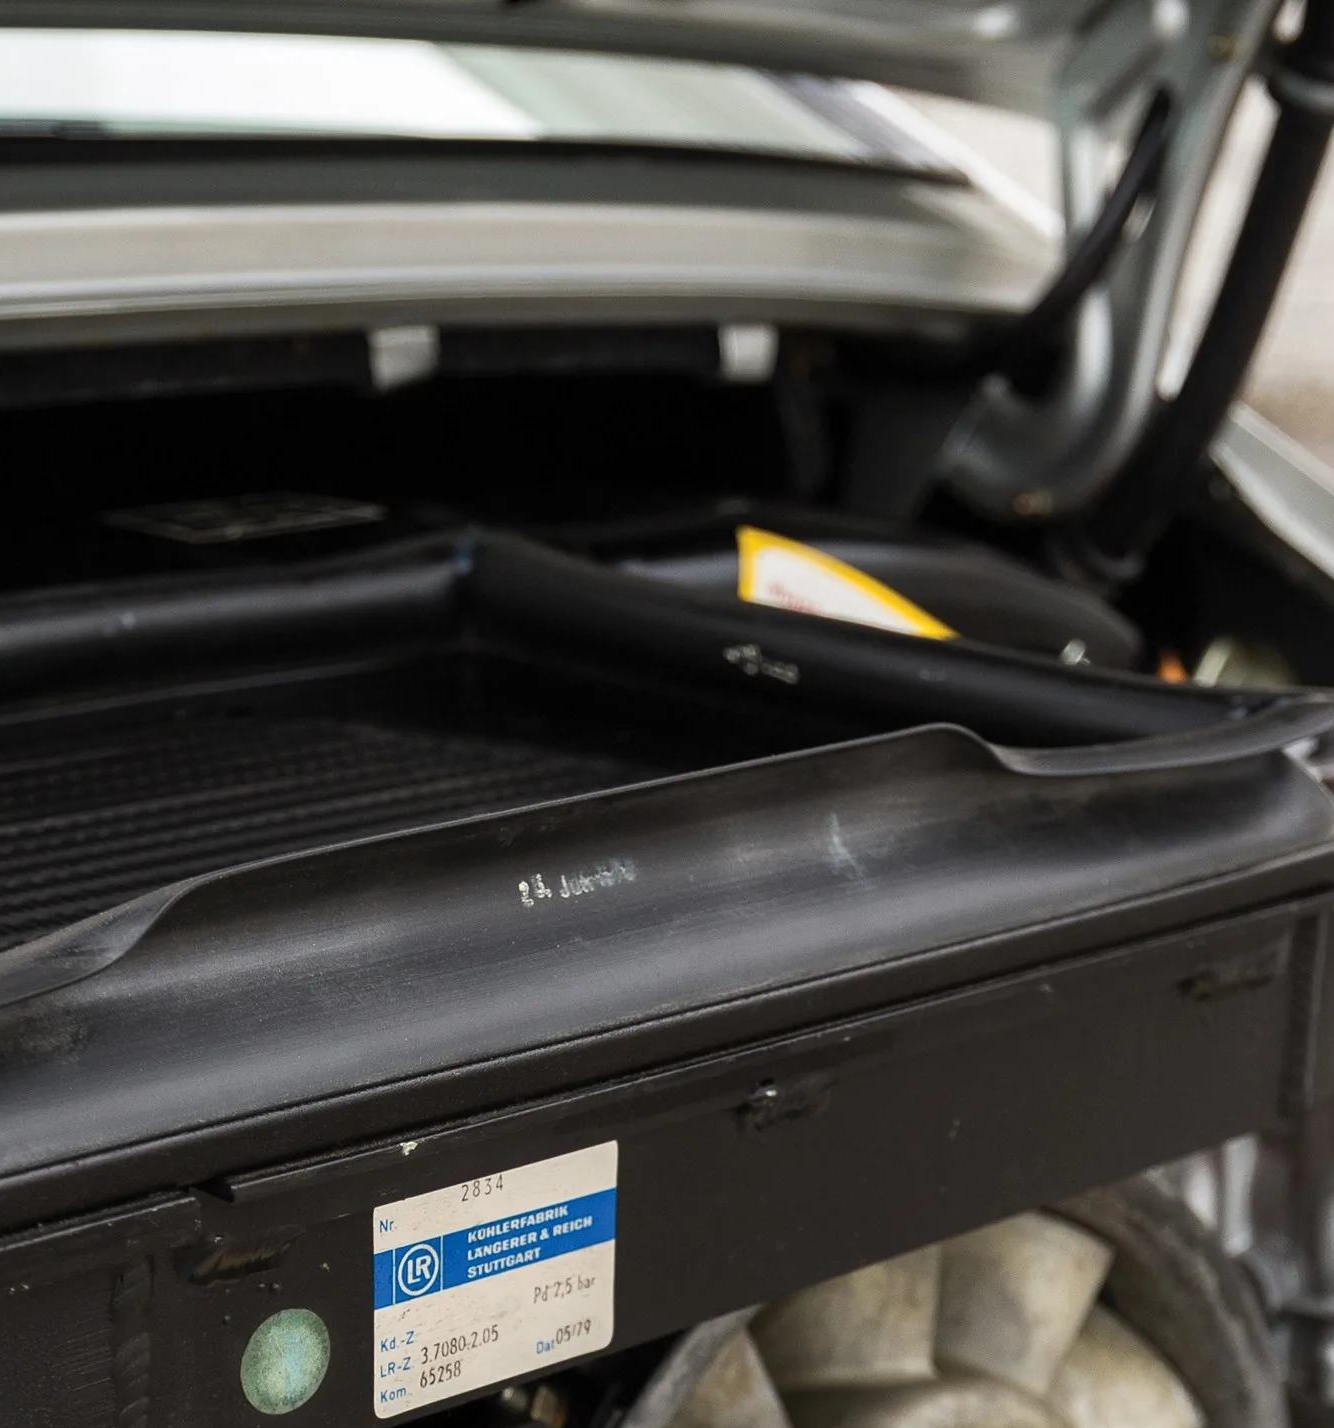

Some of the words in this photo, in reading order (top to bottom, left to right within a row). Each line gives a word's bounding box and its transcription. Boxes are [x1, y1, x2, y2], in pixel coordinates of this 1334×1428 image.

[461, 1174, 504, 1202] 2834
[539, 1228, 549, 1241] &
[552, 1215, 593, 1237] REICH
[406, 1253, 432, 1285] LR
[467, 1247, 541, 1279] STUTTGART
[577, 1275, 596, 1290] bar
[419, 1360, 462, 1389] 65258
